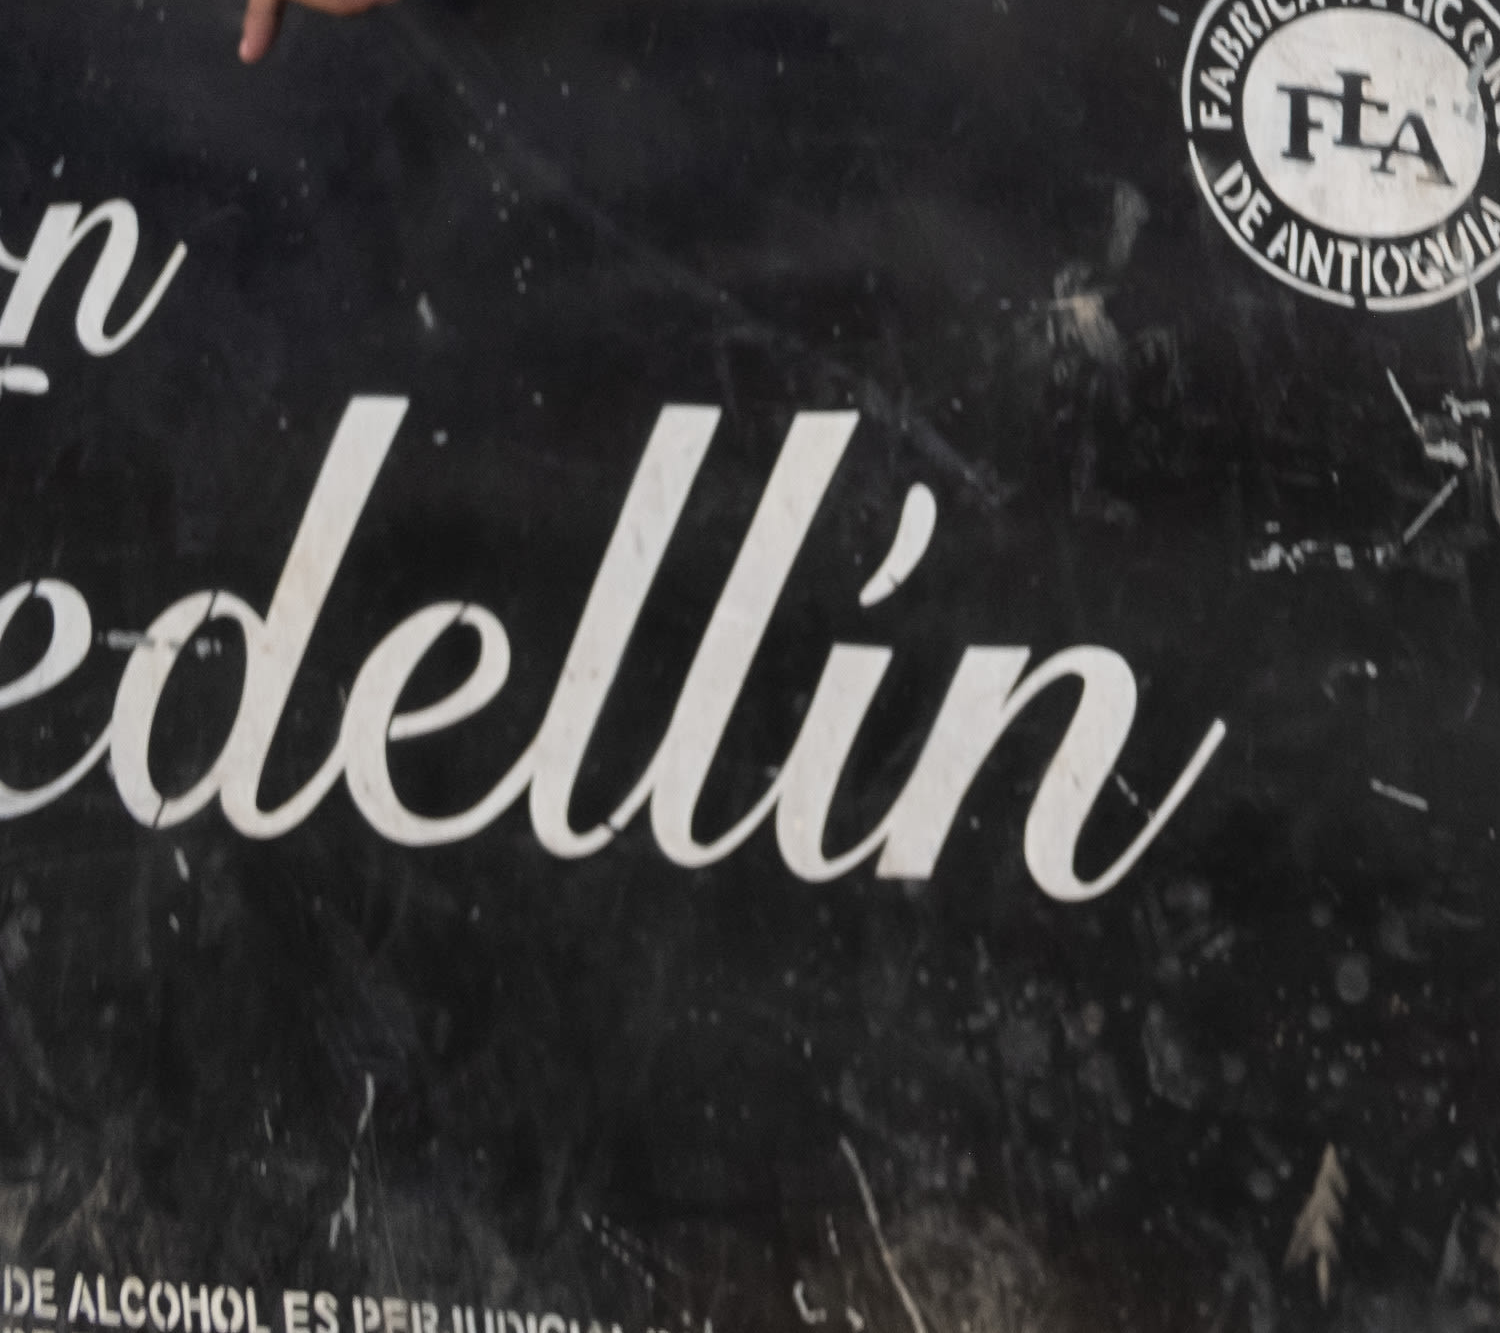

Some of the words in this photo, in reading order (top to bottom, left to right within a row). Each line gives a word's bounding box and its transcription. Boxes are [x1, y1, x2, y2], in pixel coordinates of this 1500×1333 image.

[1276, 68, 1458, 189] FLA
[1214, 160, 1273, 242] DE
[0, 365, 1225, 902] edellín
[3, 1264, 58, 1320] DE
[67, 1271, 271, 1333] ALCOHOL
[283, 1289, 340, 1333] ES
